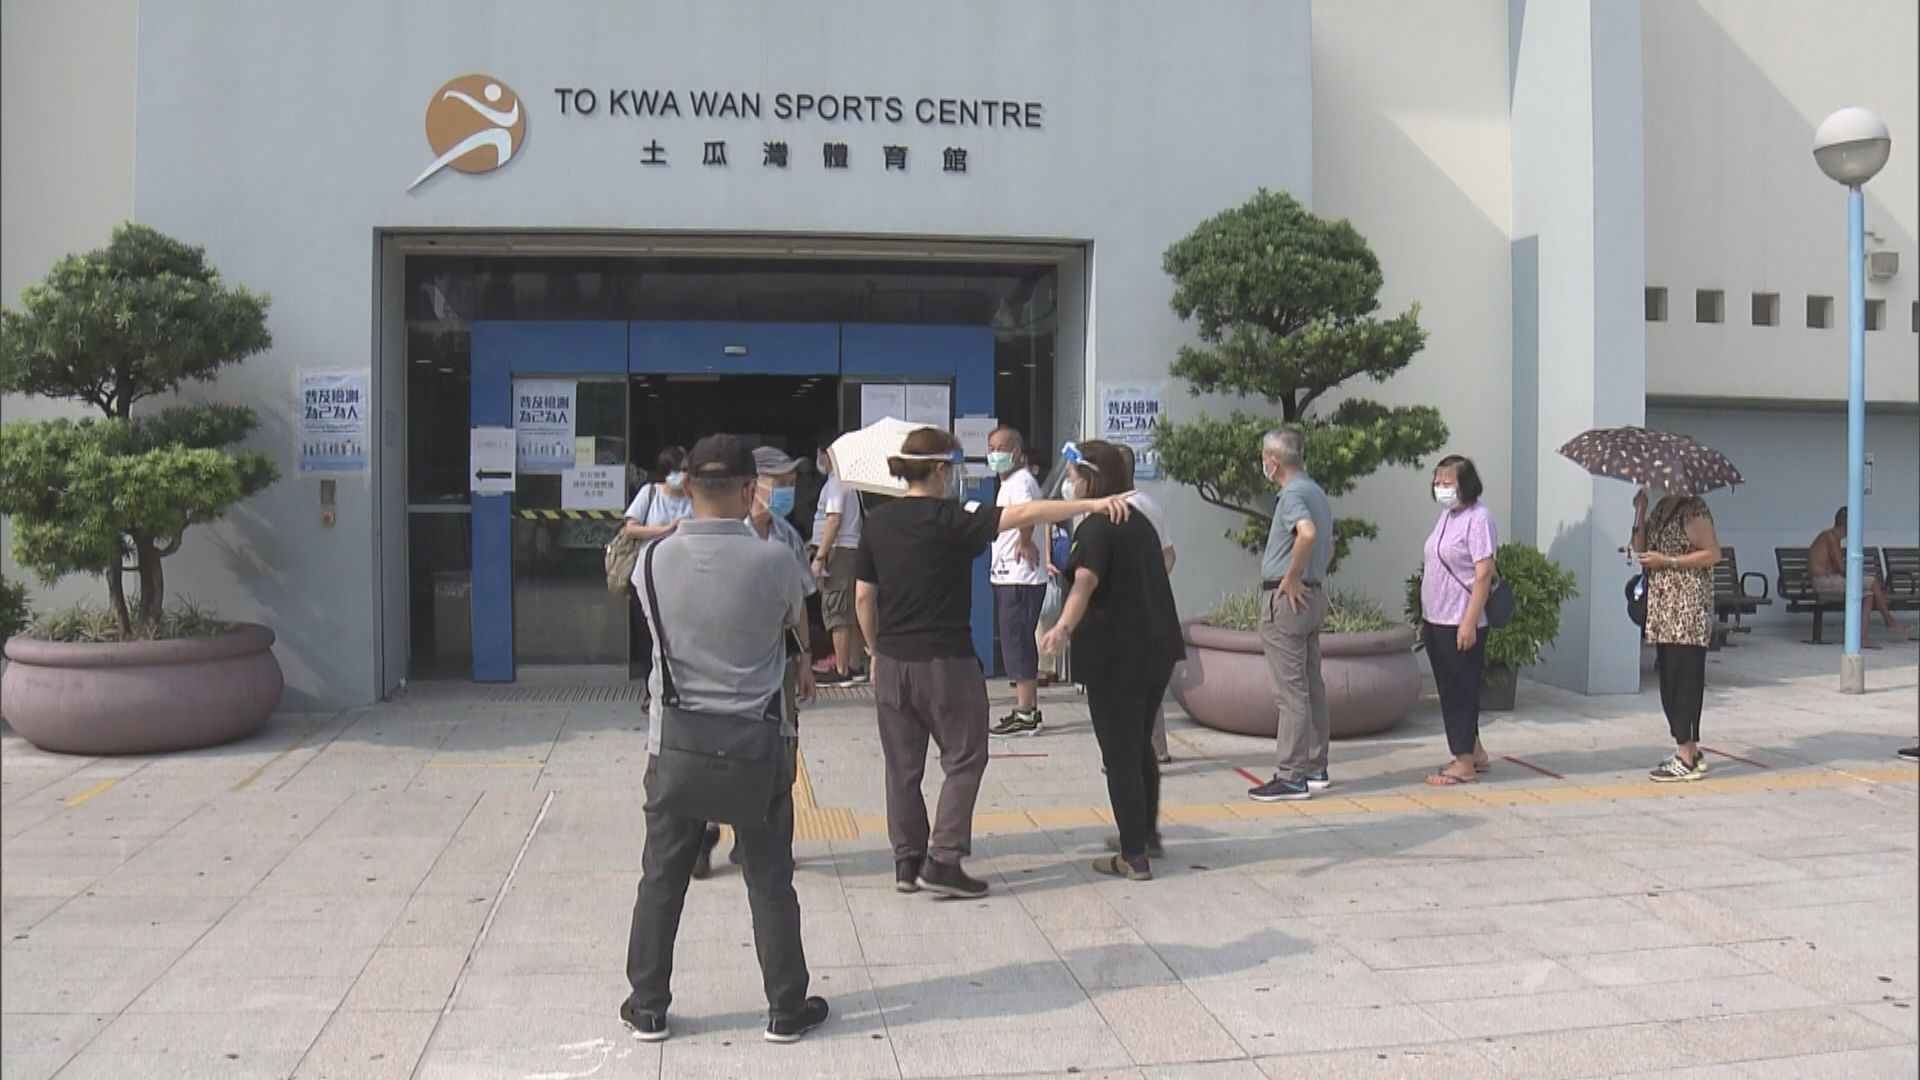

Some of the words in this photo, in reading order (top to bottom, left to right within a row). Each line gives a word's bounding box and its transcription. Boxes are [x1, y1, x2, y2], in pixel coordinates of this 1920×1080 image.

[554, 88, 597, 115] TO
[610, 89, 681, 117] KWA
[690, 91, 761, 118] WAN
[774, 93, 903, 122] SPORTS
[915, 98, 1043, 128] CENTRE
[640, 138, 968, 173] 土瓜灣體育館
[304, 387, 359, 404] 普及檢測
[519, 395, 570, 410] 普及檢測
[1108, 400, 1159, 415] 普及檢測
